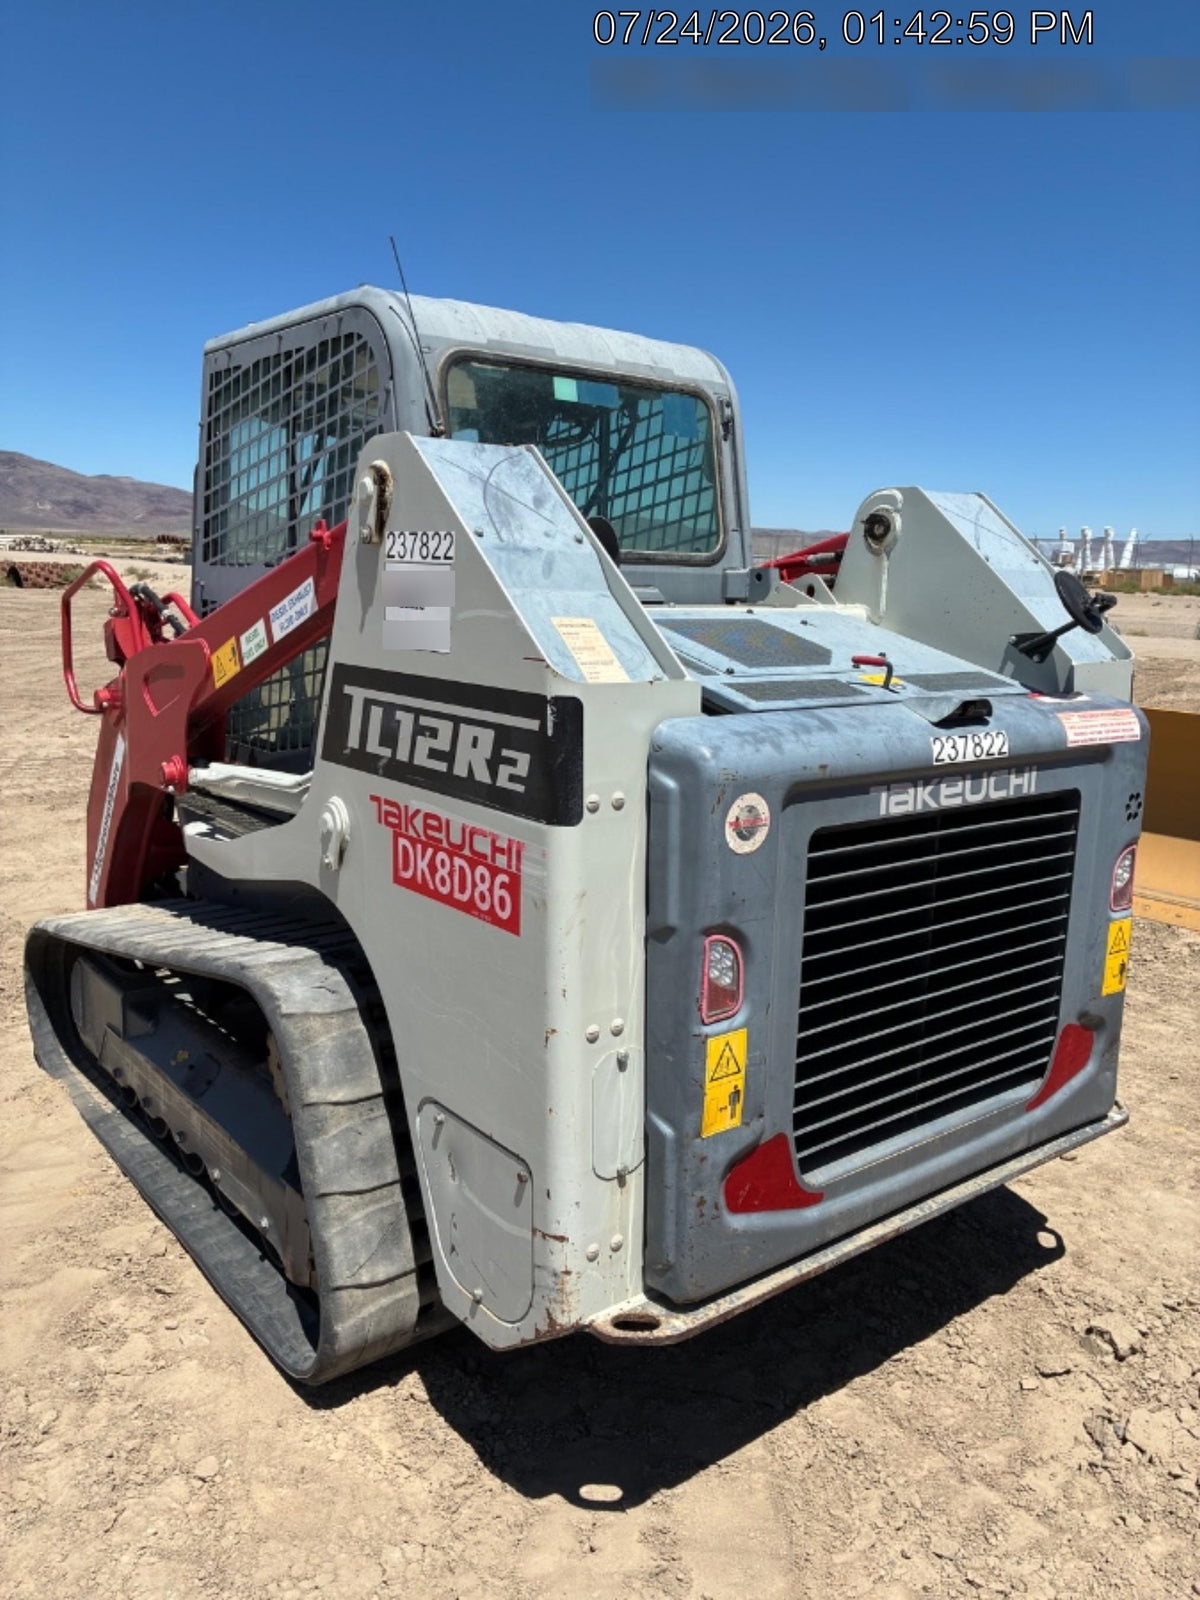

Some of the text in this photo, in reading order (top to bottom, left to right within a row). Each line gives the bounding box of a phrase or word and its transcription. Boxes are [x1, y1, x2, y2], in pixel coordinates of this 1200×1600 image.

[386, 531, 454, 560] 237822
[932, 732, 1007, 763] 237822
[869, 765, 1037, 816] TAKEUCHI
[369, 794, 525, 874] TAKEUCHI
[397, 836, 512, 920] DK8D86
